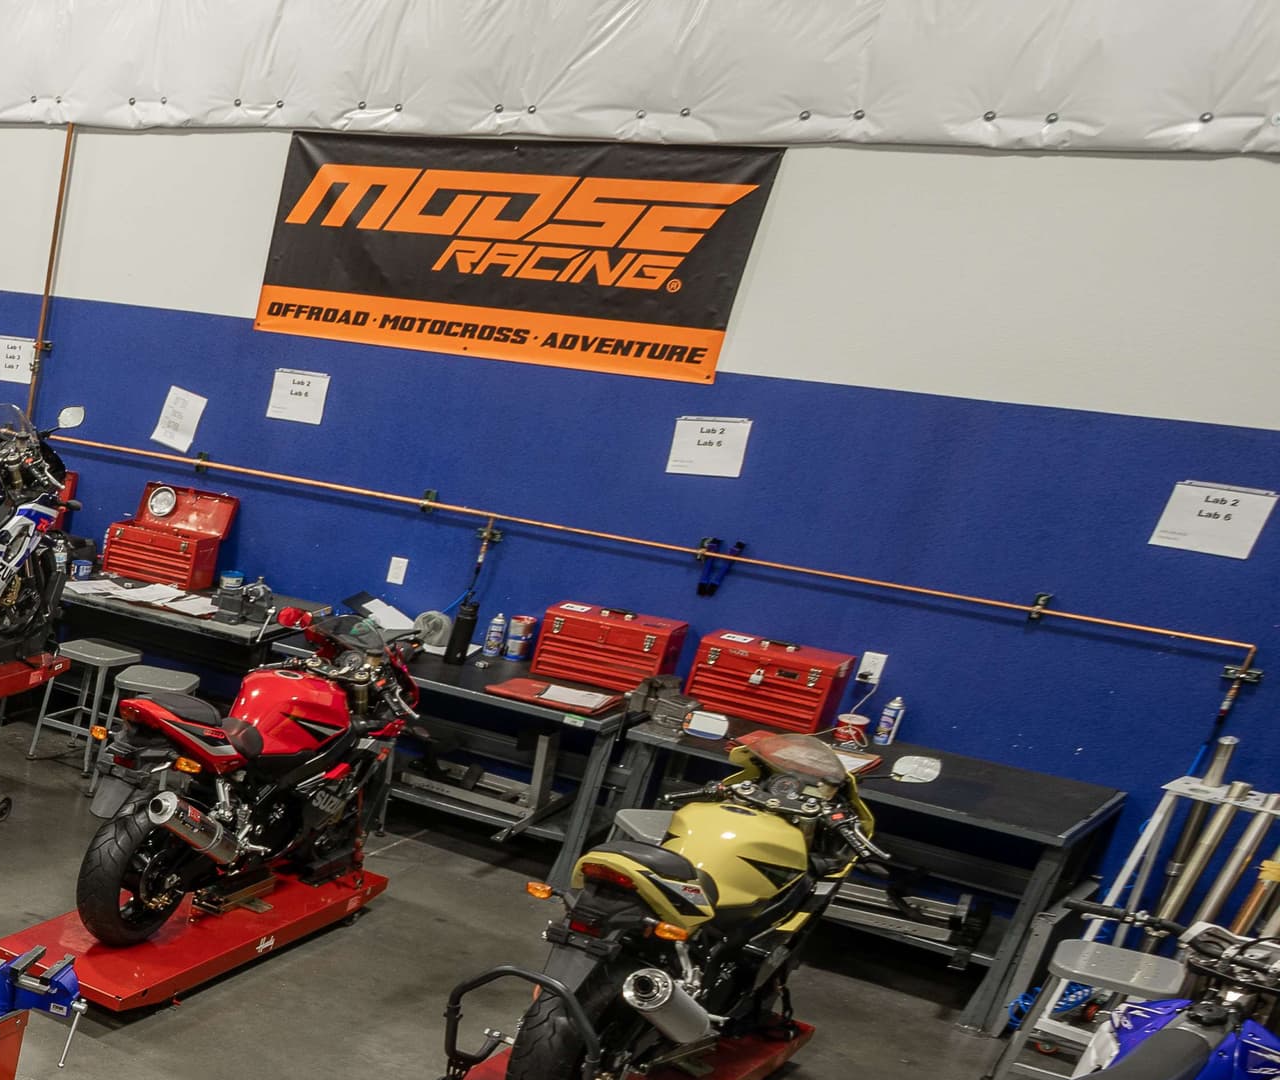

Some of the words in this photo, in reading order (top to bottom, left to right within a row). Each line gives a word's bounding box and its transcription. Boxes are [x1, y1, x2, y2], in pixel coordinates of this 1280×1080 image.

[285, 164, 760, 253] MOOSE
[267, 301, 369, 327] OFFROAD
[378, 315, 530, 345] MOTOCROSS
[541, 331, 709, 364] ADVENTURE
[290, 389, 304, 397] Lab
[718, 427, 727, 435] 2
[696, 439, 714, 447] Lab
[1204, 495, 1229, 506] Lab
[1229, 499, 1240, 507] 2
[1197, 509, 1221, 520] Lab
[1223, 513, 1233, 521] 6
